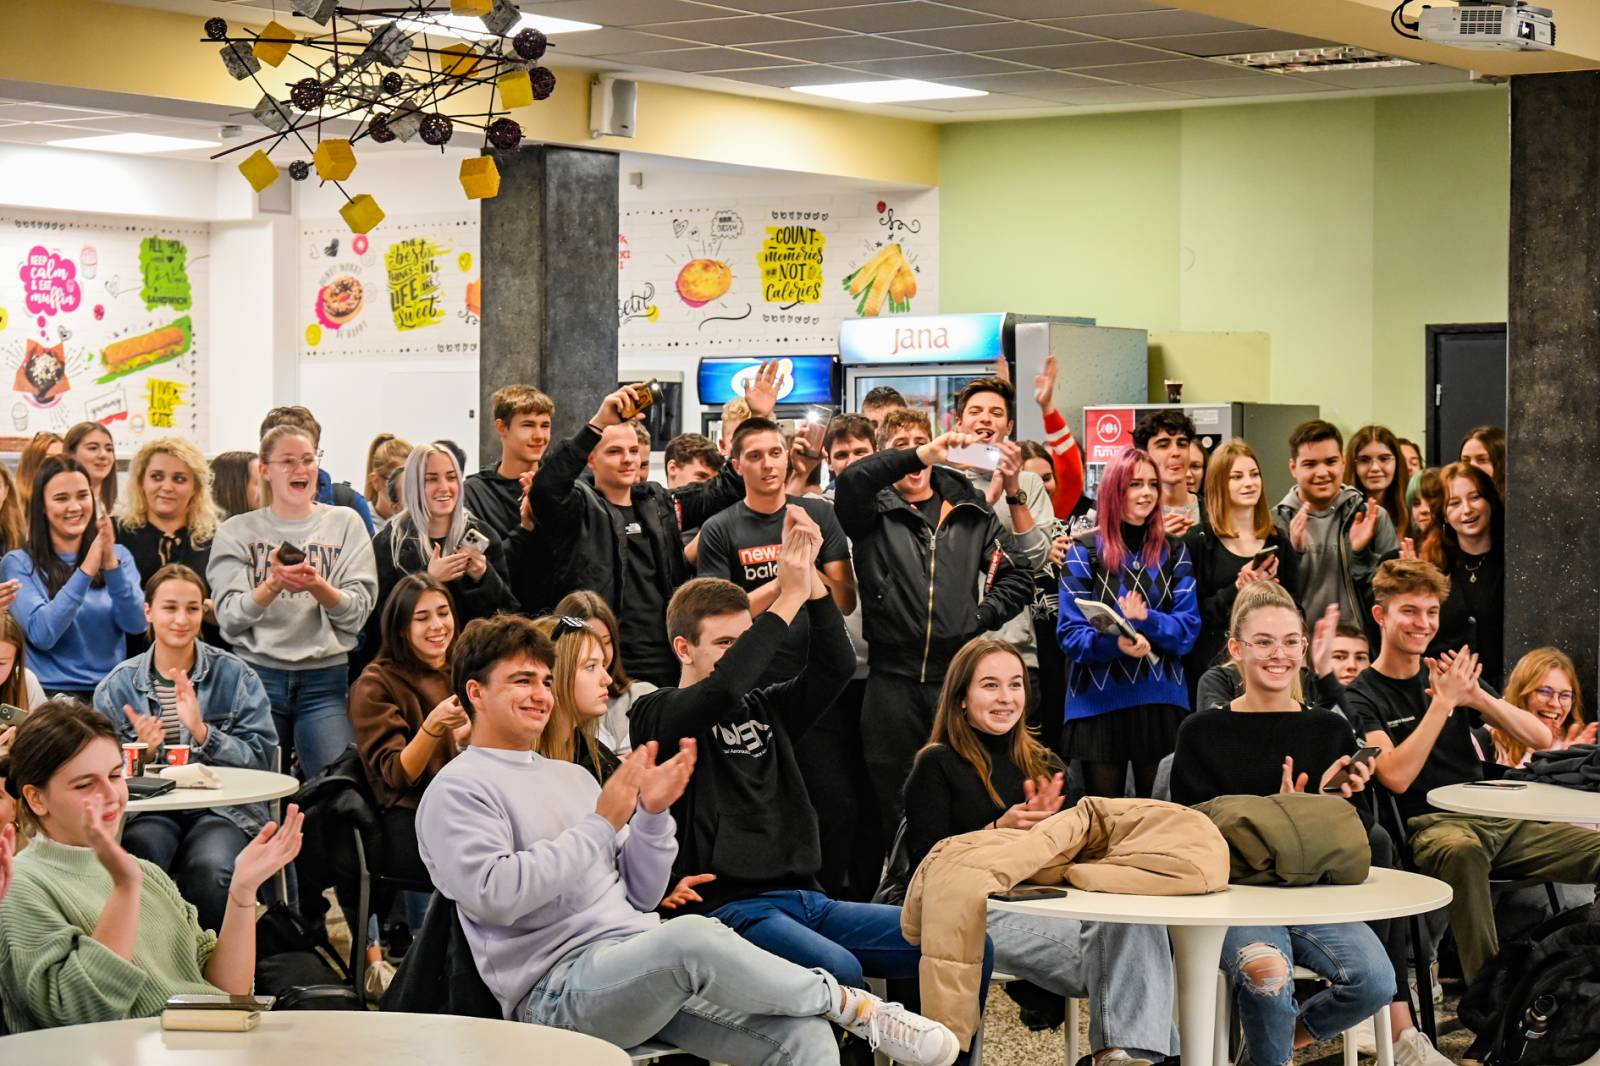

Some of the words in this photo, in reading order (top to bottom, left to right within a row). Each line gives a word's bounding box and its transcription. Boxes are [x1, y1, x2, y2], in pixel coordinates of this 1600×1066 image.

[775, 225, 817, 246] COUNT
[395, 239, 425, 266] best
[764, 246, 824, 265] memories
[30, 258, 69, 281] calm
[779, 262, 807, 282] NOT
[390, 278, 419, 313] LIFE
[891, 327, 950, 355] jana
